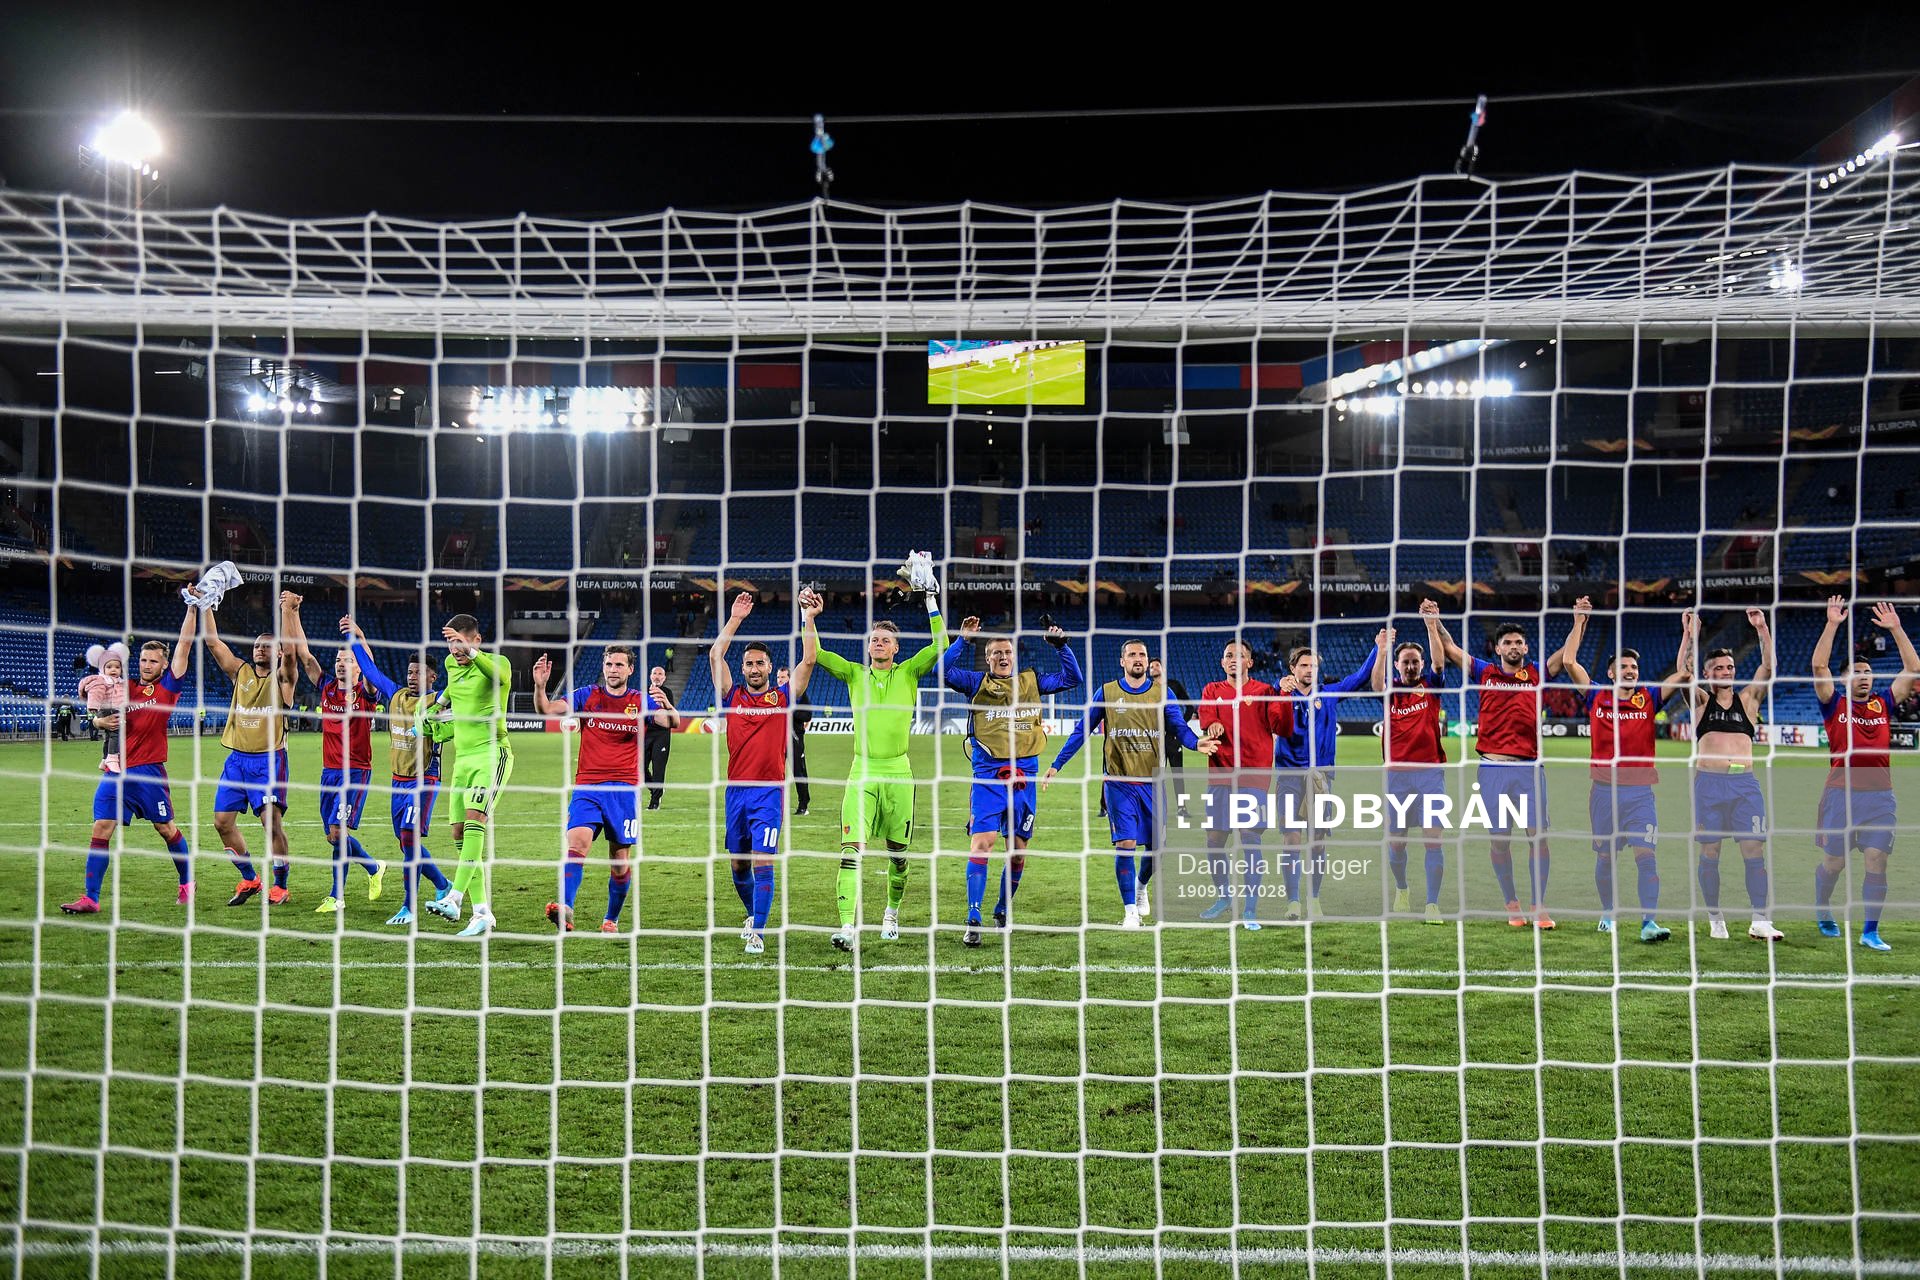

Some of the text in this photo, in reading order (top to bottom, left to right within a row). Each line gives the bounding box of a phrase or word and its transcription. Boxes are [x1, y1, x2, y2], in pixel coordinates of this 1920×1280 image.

[1849, 424, 1875, 434] UEA
[576, 581, 676, 590] UEFA EUROPA LAGUE
[943, 582, 967, 591] EFA
[967, 582, 1004, 591] EUROPA
[1309, 583, 1410, 592] UFA EUROPA LEAUE
[1705, 576, 1743, 587] EUROPA
[598, 721, 639, 733] NOVARTIS
[1781, 727, 1804, 744] FedEx
[157, 801, 167, 817] 5
[623, 818, 638, 839] 20
[904, 820, 911, 838] 1
[1022, 814, 1034, 832] 3
[762, 827, 778, 848] 10
